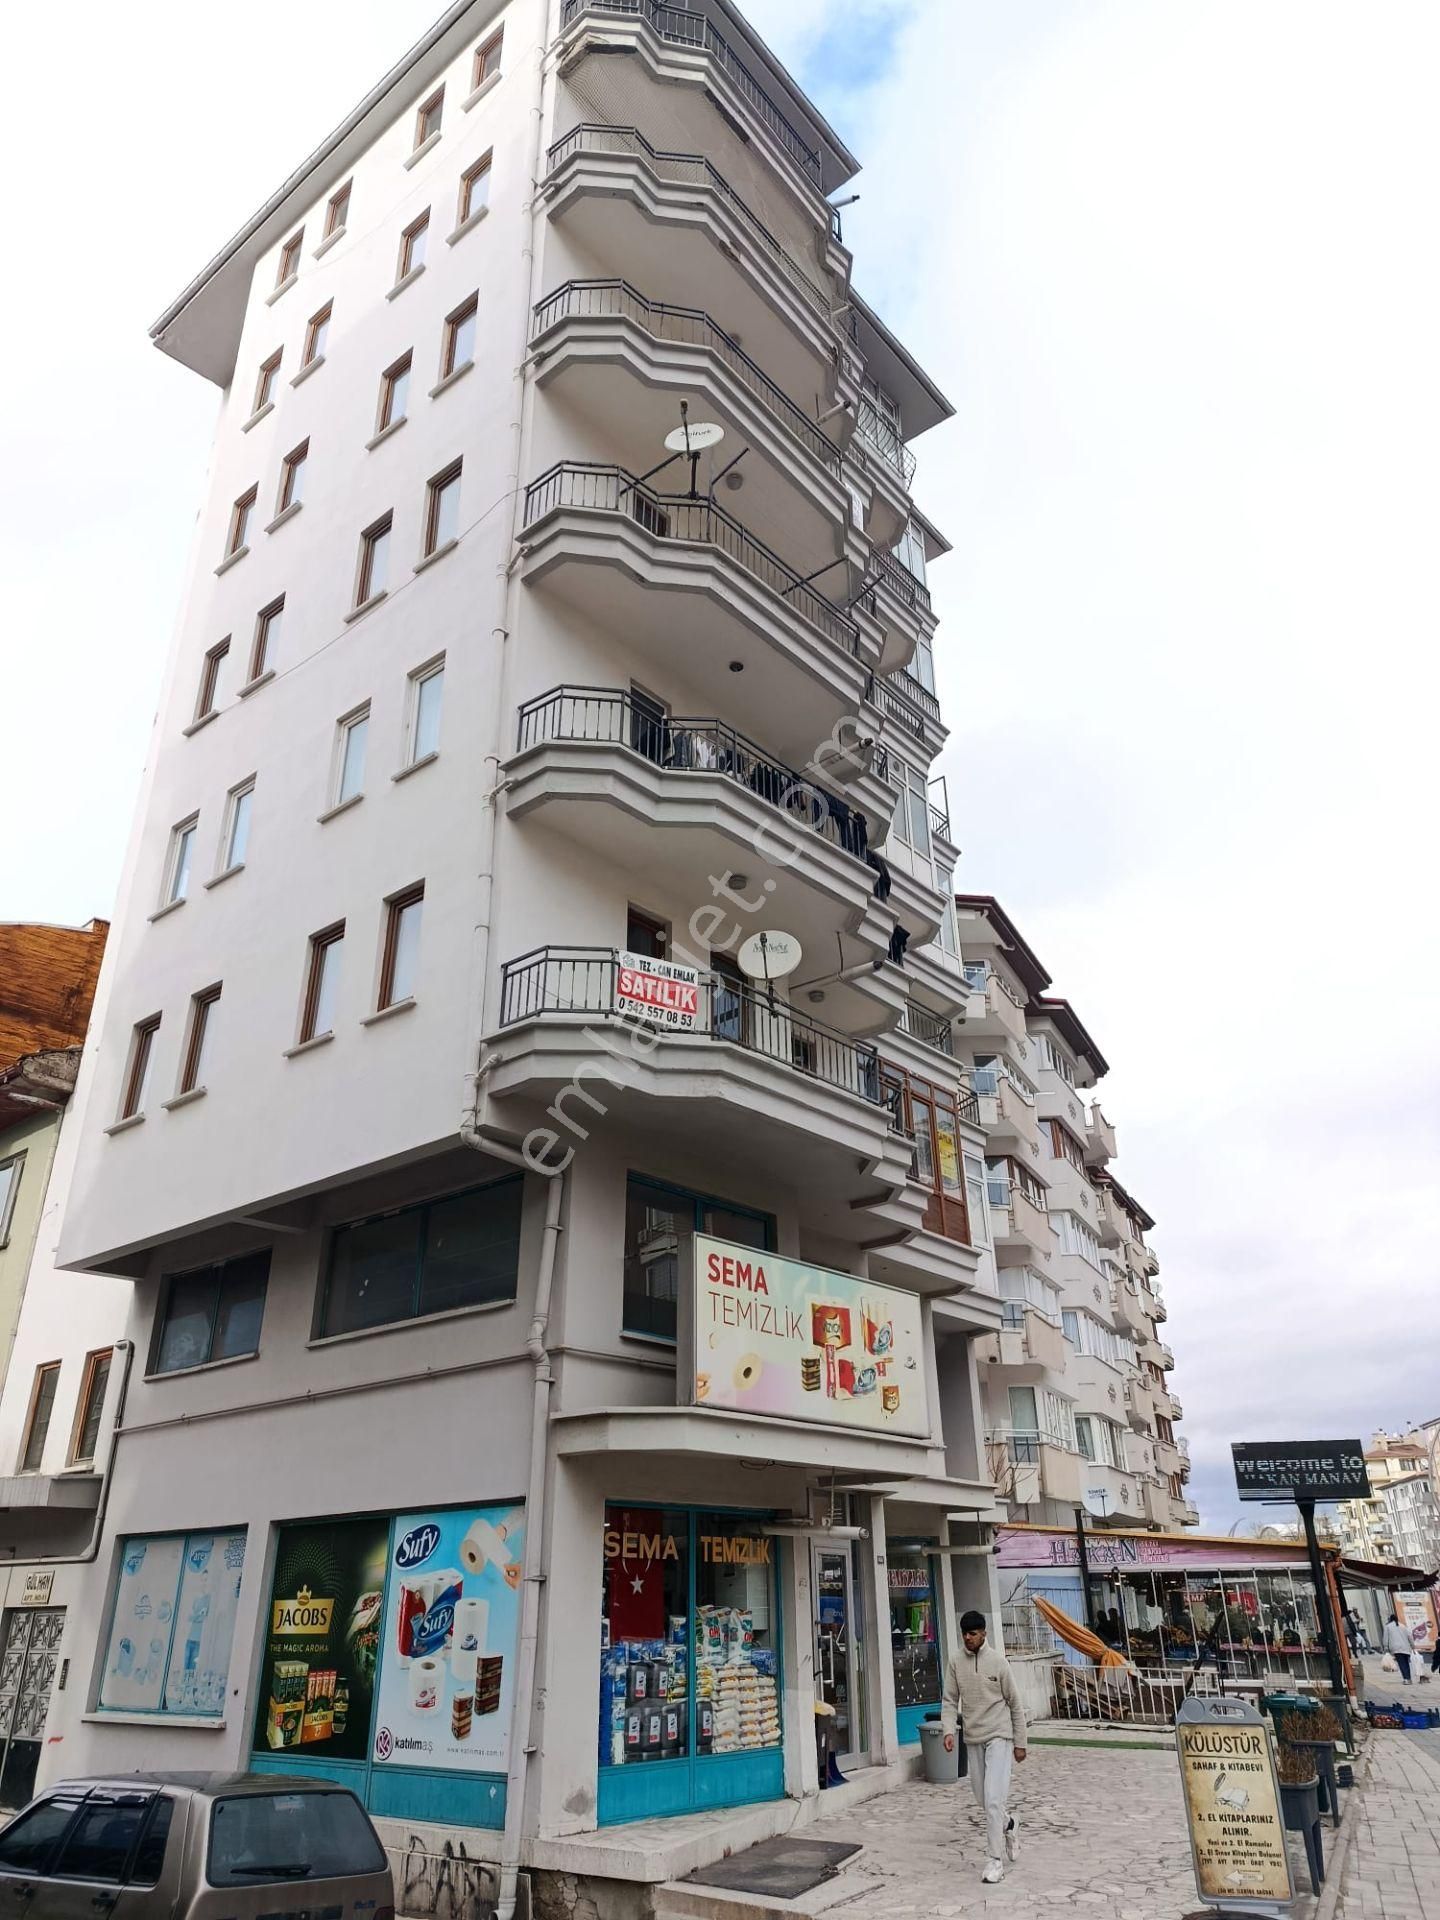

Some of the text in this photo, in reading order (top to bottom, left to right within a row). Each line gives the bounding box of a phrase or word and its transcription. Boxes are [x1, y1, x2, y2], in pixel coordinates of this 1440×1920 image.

[639, 960, 651, 972] TEZ
[673, 968, 695, 983] EMLAK
[620, 972, 696, 1011] SATILIK
[618, 997, 693, 1027] 0 542 557 08 53
[707, 1253, 769, 1296] SEMA
[707, 1291, 804, 1341] TEMİZLİK
[1235, 1453, 1364, 1473] welcome to
[1305, 1472, 1362, 1485] MANAV
[398, 1527, 438, 1564] Sufy
[604, 1531, 771, 1564] SEMA TEMİZLİK
[276, 1607, 328, 1630] JACOBS
[420, 1608, 453, 1637] Sufy
[270, 1643, 329, 1653] THE MAGIC AROMA
[1184, 1731, 1264, 1755] KÜLÜSTÜR
[1192, 1761, 1218, 1771] SAHAF
[1219, 1763, 1226, 1771] &
[1207, 1813, 1217, 1822] EL
[1218, 1813, 1274, 1824] KİTAPLARINIZ
